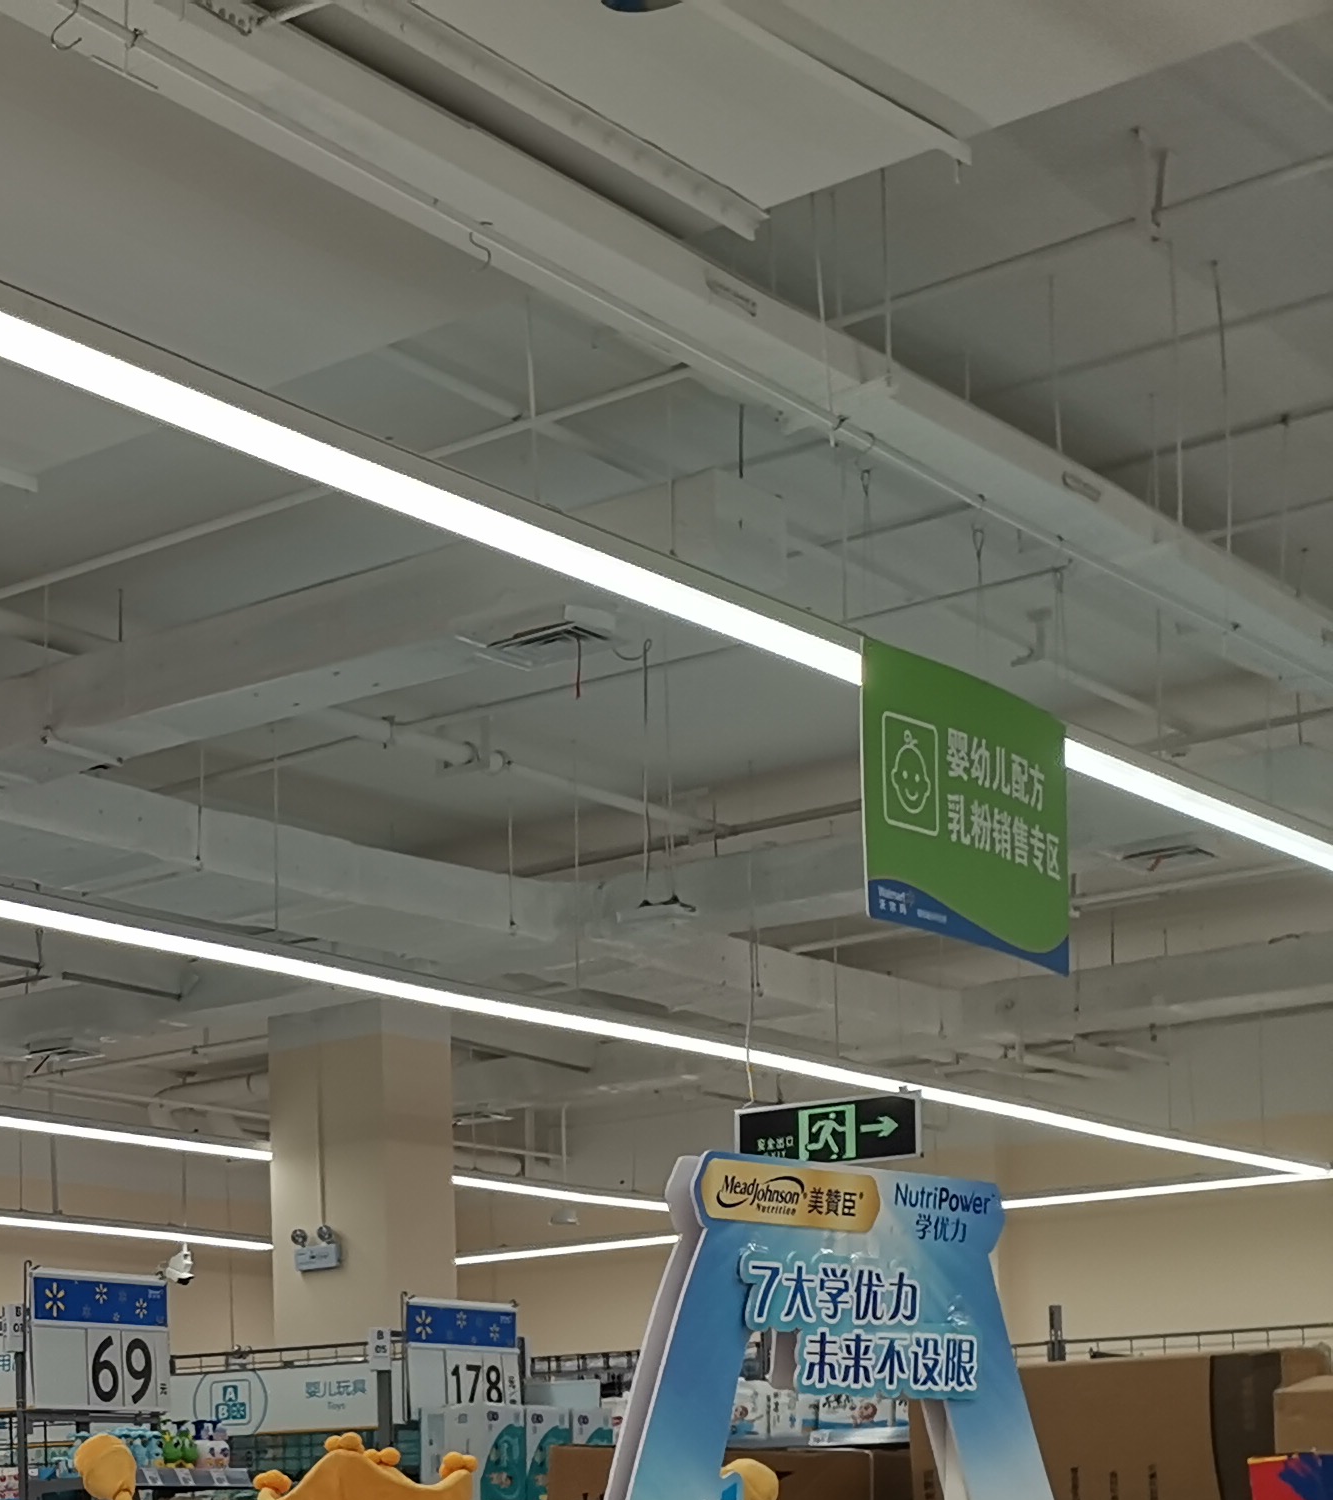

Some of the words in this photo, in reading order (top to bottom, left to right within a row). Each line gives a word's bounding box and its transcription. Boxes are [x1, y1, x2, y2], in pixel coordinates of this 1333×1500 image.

[947, 727, 1045, 812] 婴幼儿配方
[947, 793, 1061, 881] 乳粉销售专区
[757, 1135, 794, 1151] 安全出口
[755, 1203, 797, 1217] Nutrition
[894, 1182, 992, 1216] NutriPower
[915, 1213, 967, 1243] 学优力
[746, 1263, 920, 1326] 7大学优力
[91, 1335, 153, 1405] 69
[802, 1331, 979, 1392] 未来不设限
[305, 1378, 367, 1398] 婴儿玩具
[450, 1364, 503, 1404] 178
